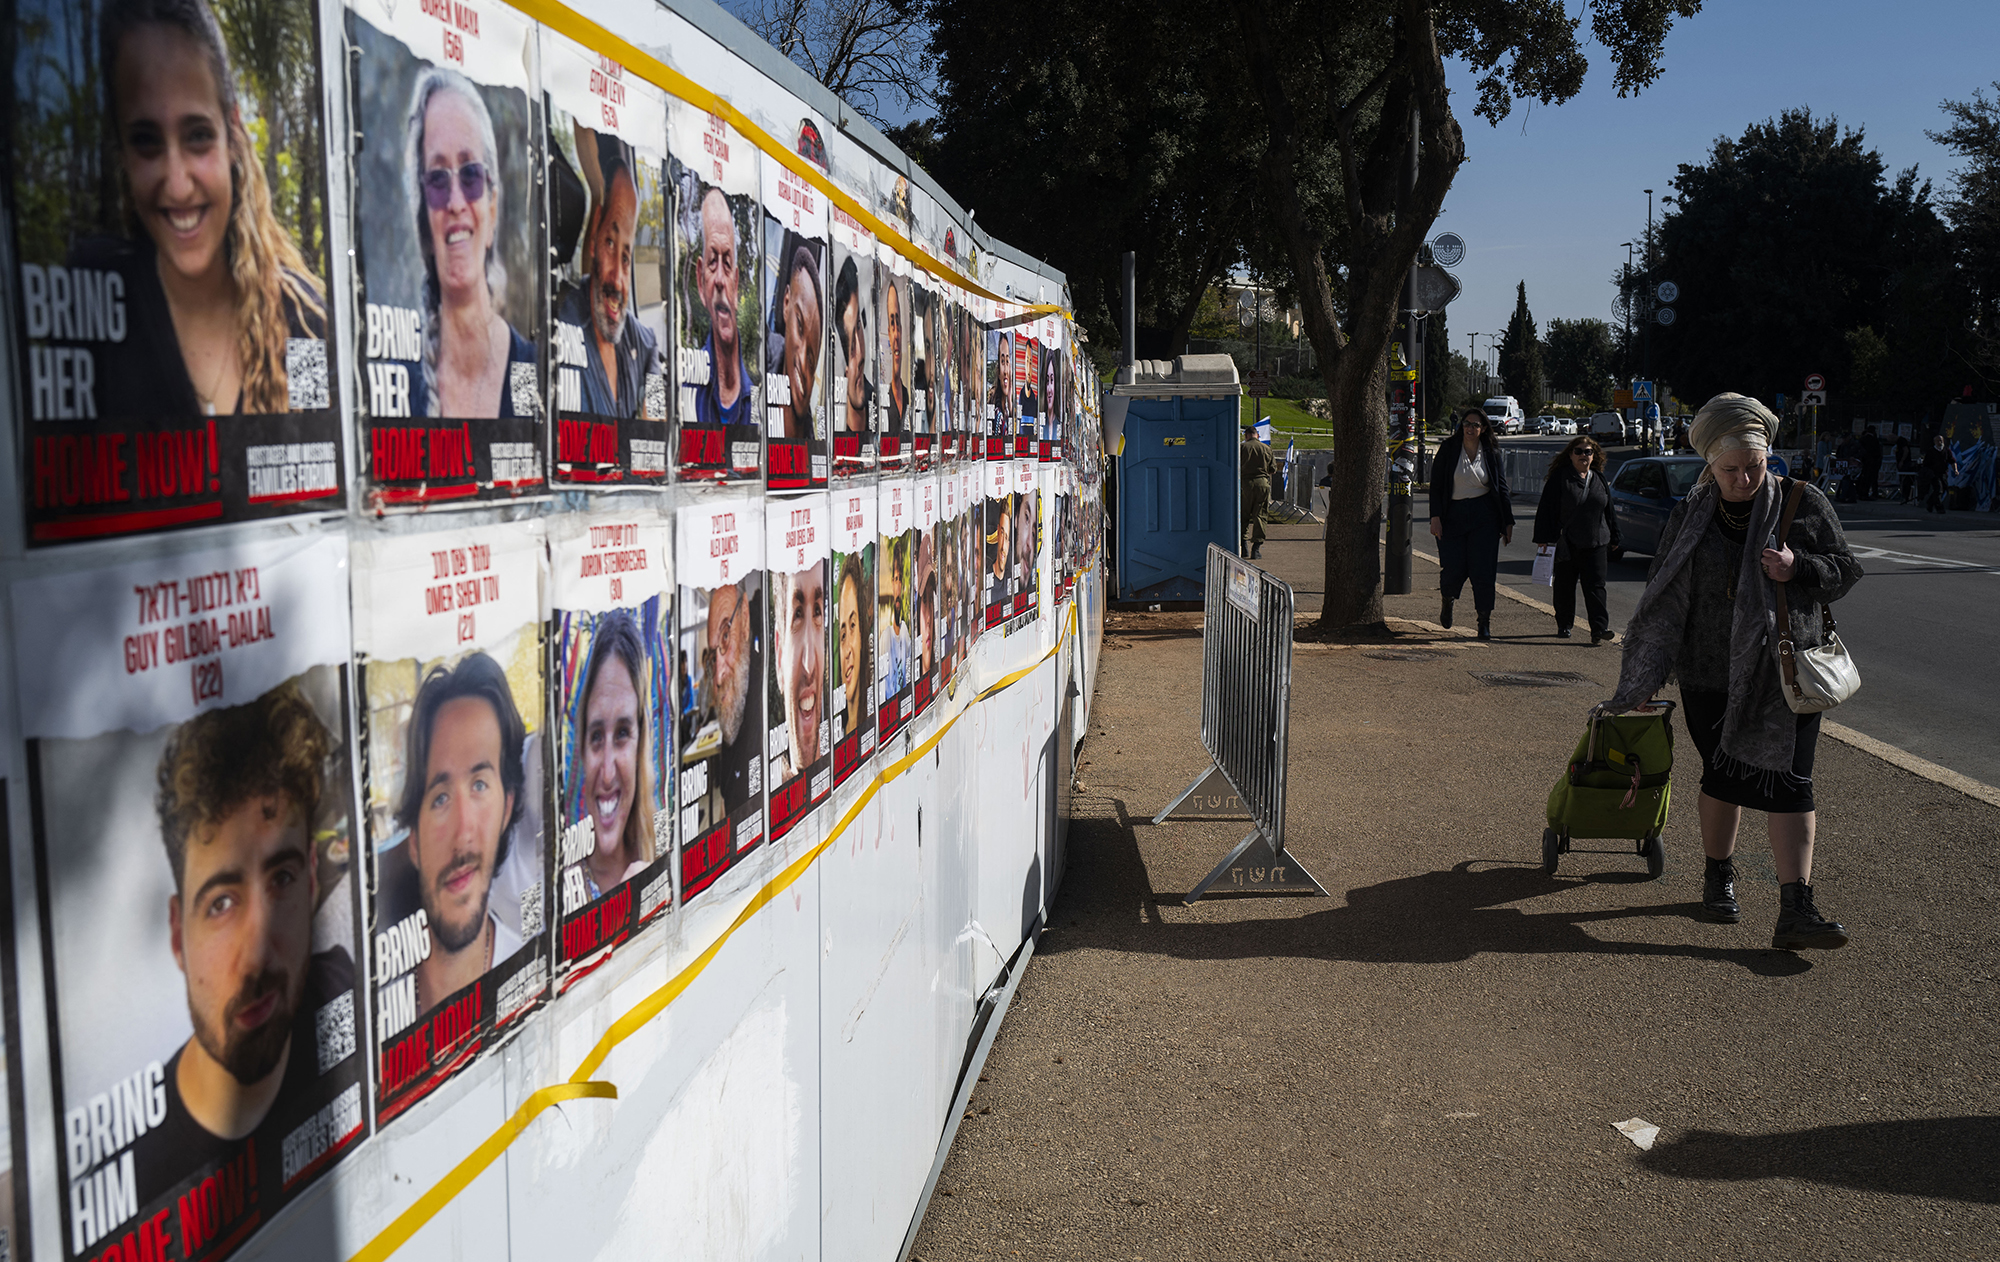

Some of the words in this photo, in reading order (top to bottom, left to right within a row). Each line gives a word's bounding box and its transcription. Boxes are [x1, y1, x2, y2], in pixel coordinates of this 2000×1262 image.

[443, 26, 464, 67] (56)
[589, 69, 608, 99] EITAN
[609, 79, 626, 107] LEVY
[601, 101, 620, 132] (53)
[22, 263, 126, 343] BRING
[365, 302, 422, 362] BRING
[31, 348, 97, 421] HER
[367, 362, 411, 418] HER
[681, 347, 711, 386] BRING
[767, 371, 791, 407] BRING
[767, 405, 785, 440] HIM
[34, 432, 130, 508] HOME
[136, 420, 220, 497] NOW!
[371, 427, 427, 481] HOME
[428, 421, 476, 477] NOW!
[768, 444, 793, 474] HOME
[248, 464, 297, 497] FAMILIES
[580, 554, 602, 578] DORON
[604, 549, 647, 574] STEINBRECHER
[610, 576, 623, 603] (30)
[425, 584, 455, 615] OMER
[456, 578, 482, 608] SHEM
[483, 575, 500, 602] TOV
[123, 630, 159, 675] GUY
[164, 605, 275, 666] GILBOA-DALAL
[458, 611, 475, 645] (21)
[192, 662, 224, 707] (22)
[681, 761, 709, 808] BRING
[561, 814, 595, 869] BRING
[681, 802, 701, 846] HIM
[681, 827, 709, 886] HOME
[708, 817, 731, 869] NOW!
[562, 864, 587, 916] HER
[375, 906, 431, 986] BRING
[562, 895, 598, 959] HOME
[599, 882, 633, 941] NOW!
[377, 972, 417, 1043] HIM
[380, 1025, 431, 1100] HOME
[432, 981, 482, 1066] NOW!
[65, 1058, 167, 1178] BRING
[71, 1149, 138, 1257] HIM
[177, 1138, 258, 1255] NOW!
